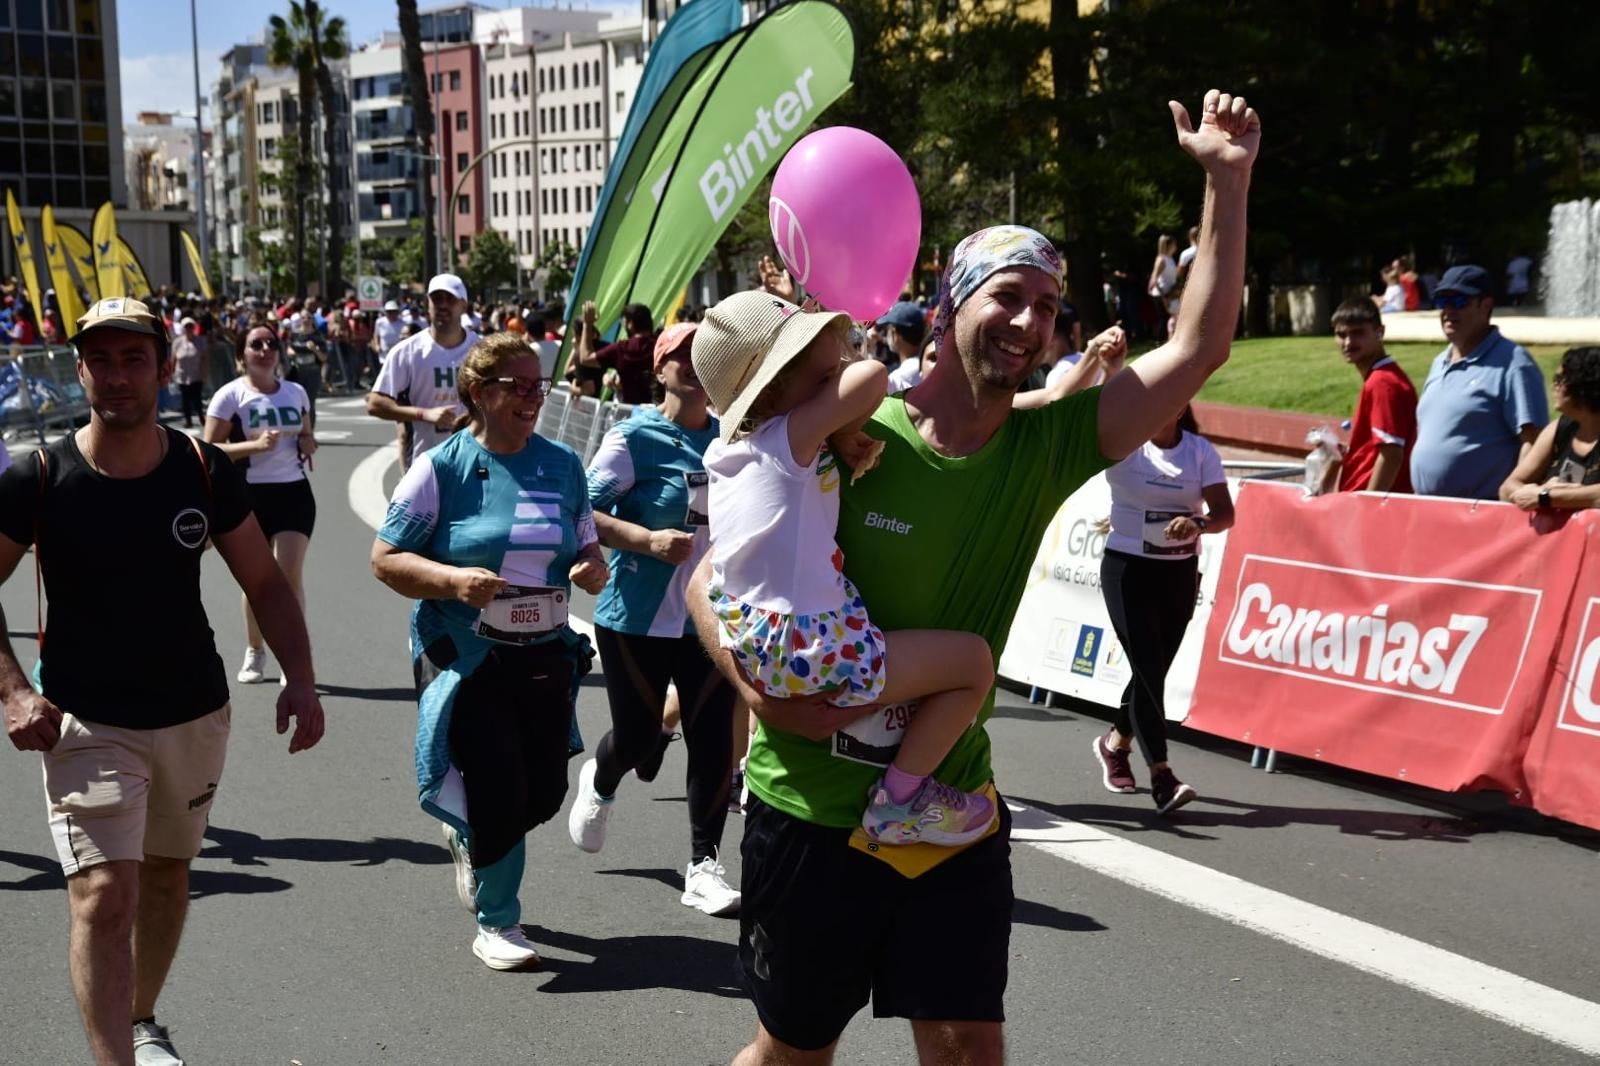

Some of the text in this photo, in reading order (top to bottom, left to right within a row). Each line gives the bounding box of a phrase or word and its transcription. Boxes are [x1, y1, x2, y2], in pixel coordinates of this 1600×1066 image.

[698, 66, 815, 223] Binter
[434, 366, 459, 388] H
[249, 406, 302, 428] HD
[864, 511, 913, 535] Binter
[510, 608, 540, 624] 8025
[1226, 582, 1489, 695] Canarias7
